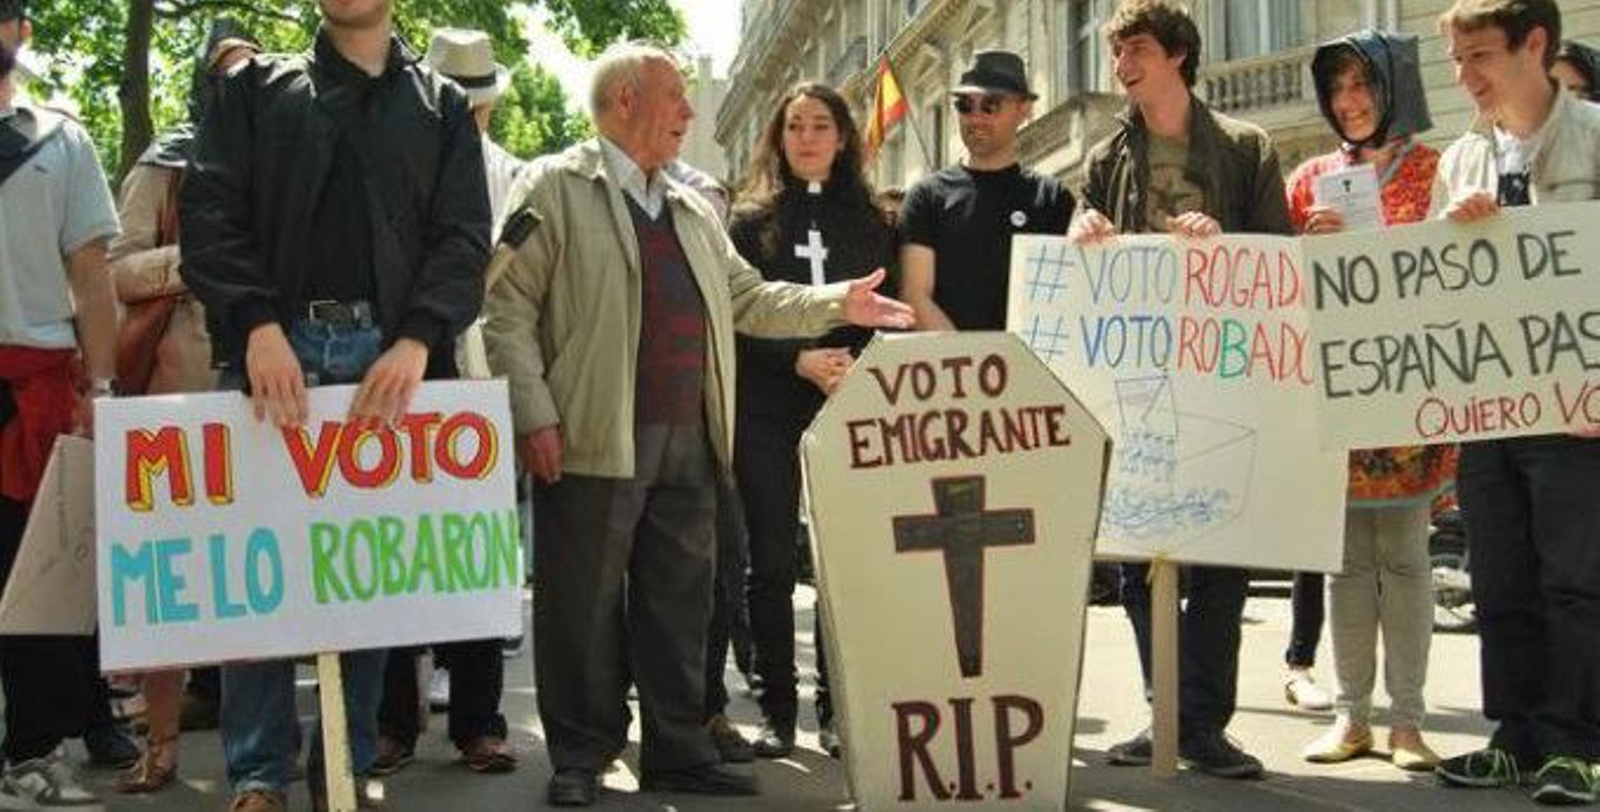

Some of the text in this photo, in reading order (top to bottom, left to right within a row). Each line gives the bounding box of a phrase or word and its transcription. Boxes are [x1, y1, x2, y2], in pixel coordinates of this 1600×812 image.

[1184, 245, 1306, 309] ROGAD
[1312, 230, 1581, 310] NO PASO DE
[868, 354, 1008, 405] VOTO
[1320, 319, 1513, 398] ESPAÑA
[847, 405, 1072, 469] EMIGRANTE
[1415, 392, 1542, 439] QUIERO
[125, 423, 234, 511] MI
[279, 411, 499, 498] VOTO
[111, 509, 520, 626] ME LO ROBARON
[892, 694, 1046, 802] R.I.P.
